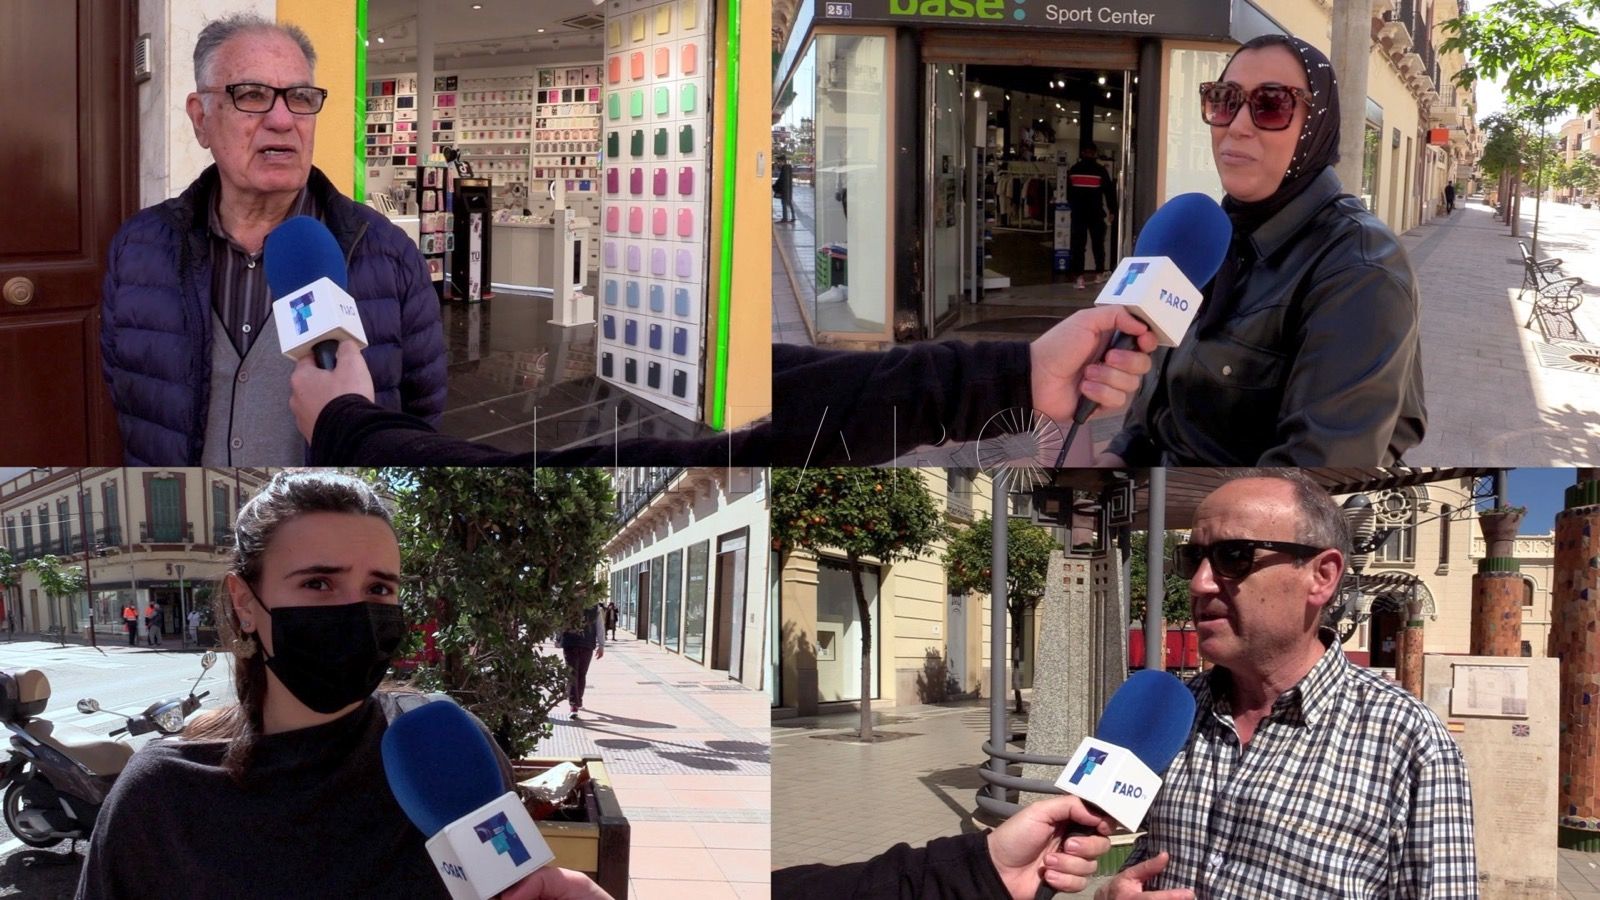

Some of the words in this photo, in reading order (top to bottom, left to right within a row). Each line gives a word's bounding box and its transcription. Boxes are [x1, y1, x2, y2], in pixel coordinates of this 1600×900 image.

[1046, 4, 1093, 24] Sport
[1098, 7, 1155, 25] Center
[1160, 289, 1189, 312] FARO
[1112, 781, 1143, 799] FARO
